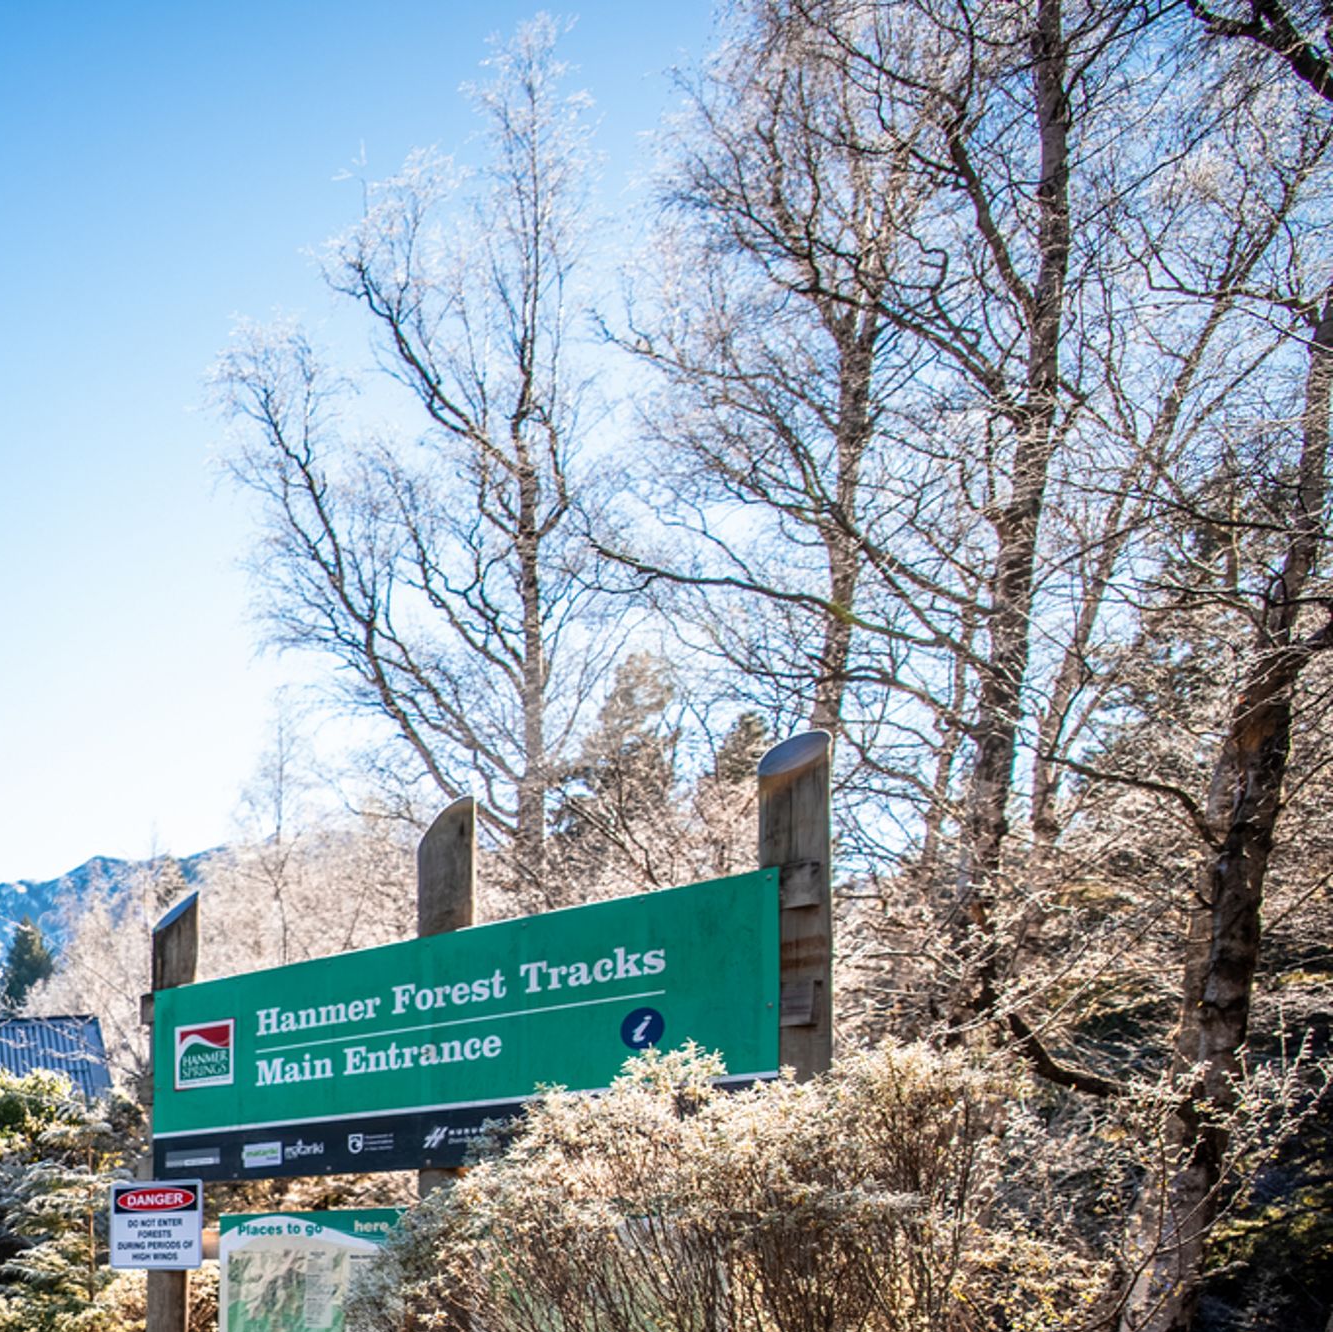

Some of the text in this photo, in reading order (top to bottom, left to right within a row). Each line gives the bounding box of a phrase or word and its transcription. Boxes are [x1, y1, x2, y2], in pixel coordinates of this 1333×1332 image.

[255, 946, 666, 1037] Hanmer Forest Tracks
[181, 1049, 229, 1068] HANMER
[255, 1035, 502, 1087] Main Entrance
[181, 1063, 228, 1080] SPRINGS
[127, 1192, 184, 1207] DANGER
[127, 1217, 183, 1228] DO NOT ENTER
[237, 1220, 389, 1236] Places to go here
[137, 1229, 172, 1239] FORESTS
[117, 1239, 194, 1251] DURING PERIODS OF
[132, 1252, 178, 1261] HIGH WINDS
